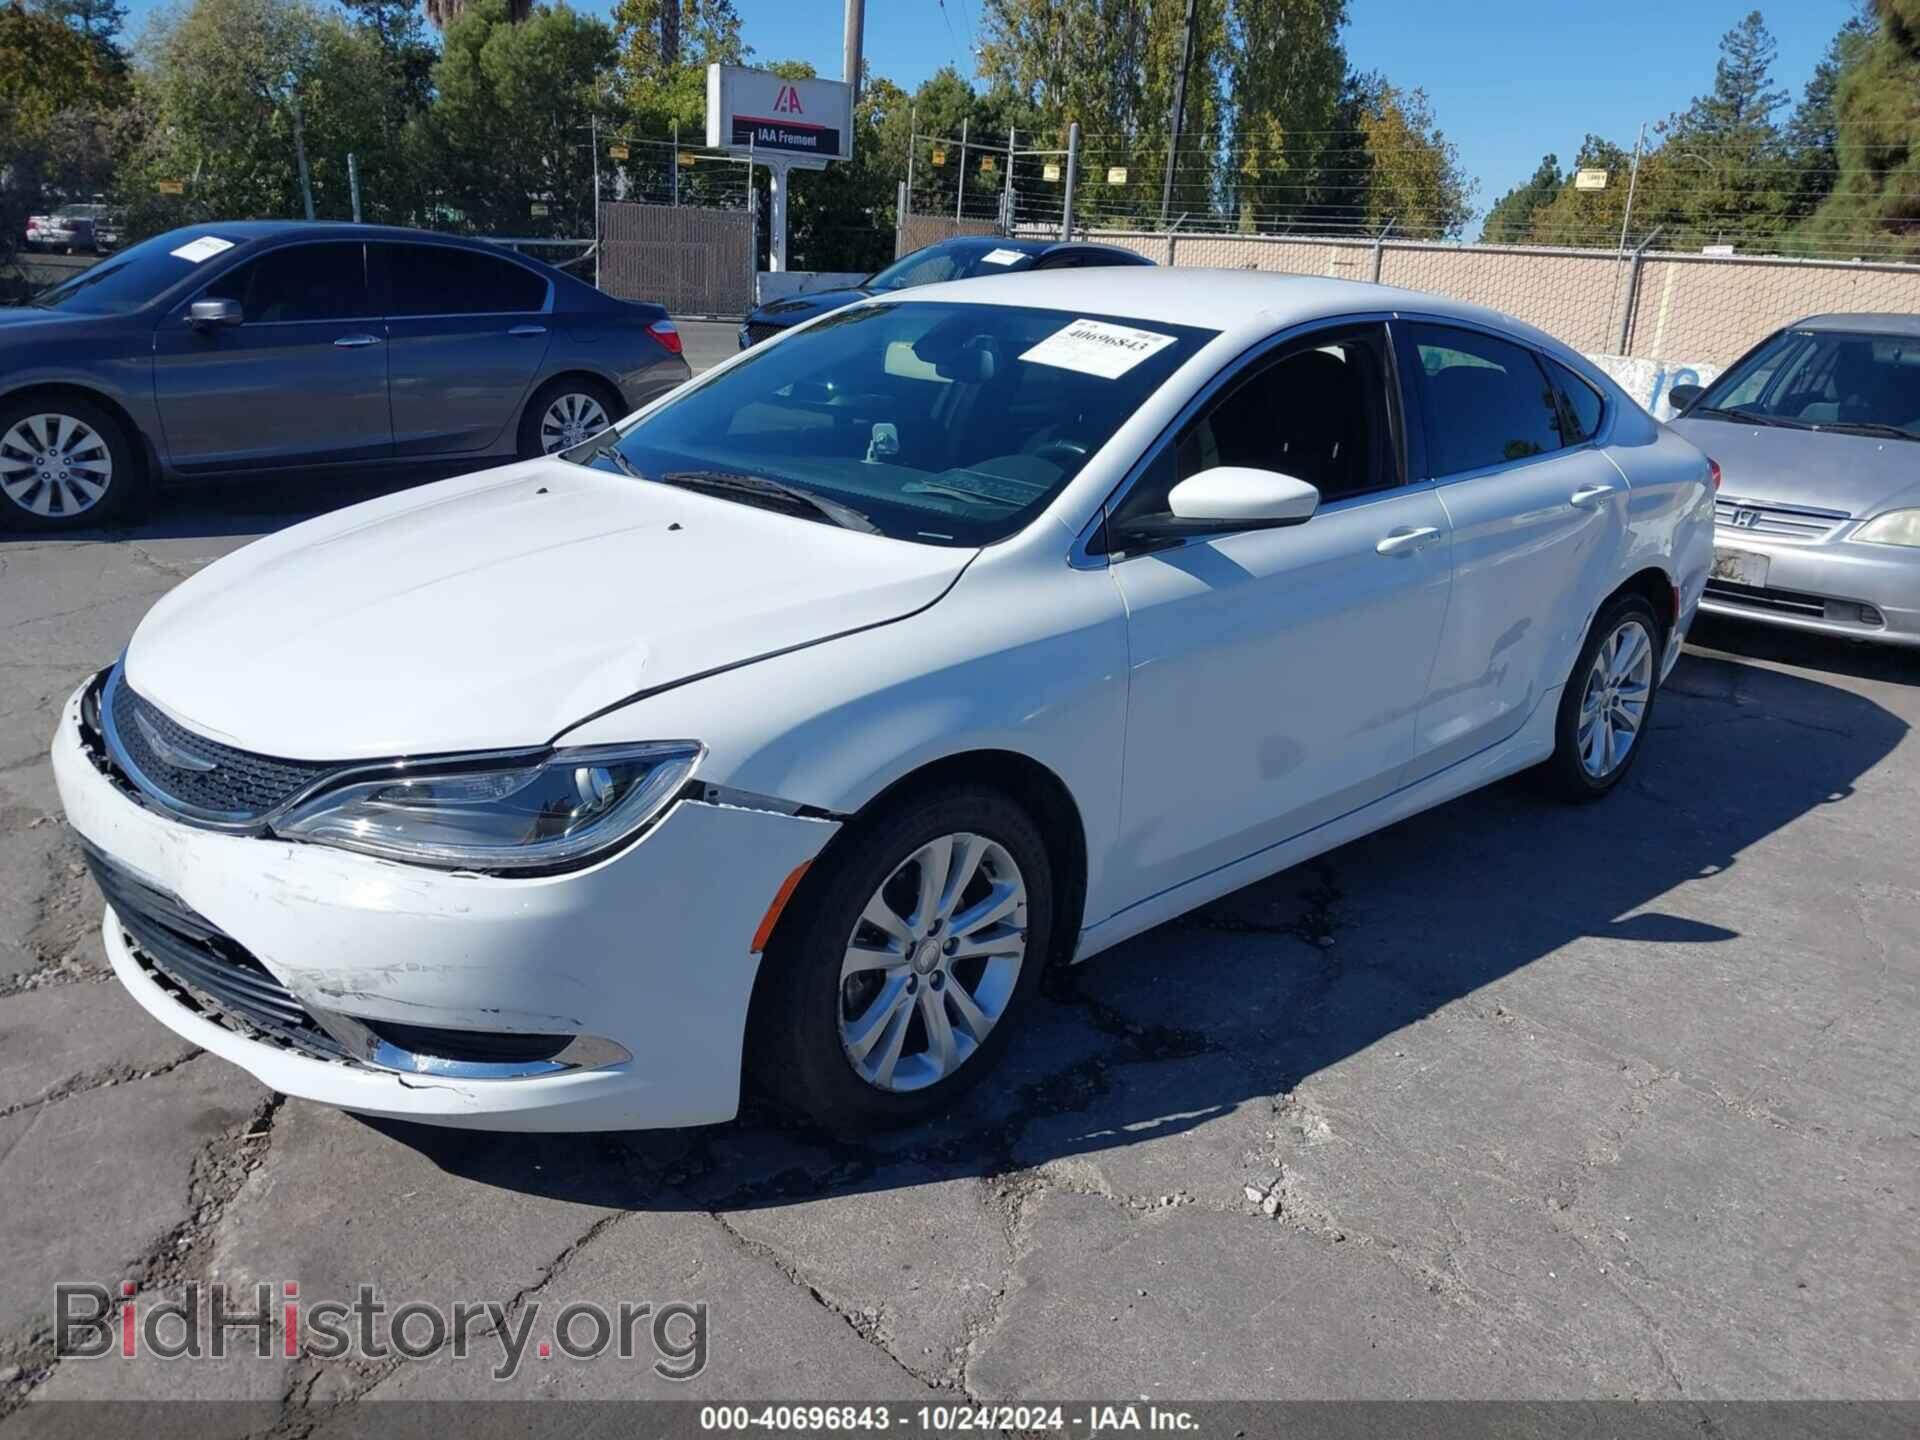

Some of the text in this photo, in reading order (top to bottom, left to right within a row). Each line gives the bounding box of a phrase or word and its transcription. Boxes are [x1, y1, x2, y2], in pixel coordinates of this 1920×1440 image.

[758, 127, 817, 147] IAA Fremont
[1068, 329, 1149, 351] 40696843
